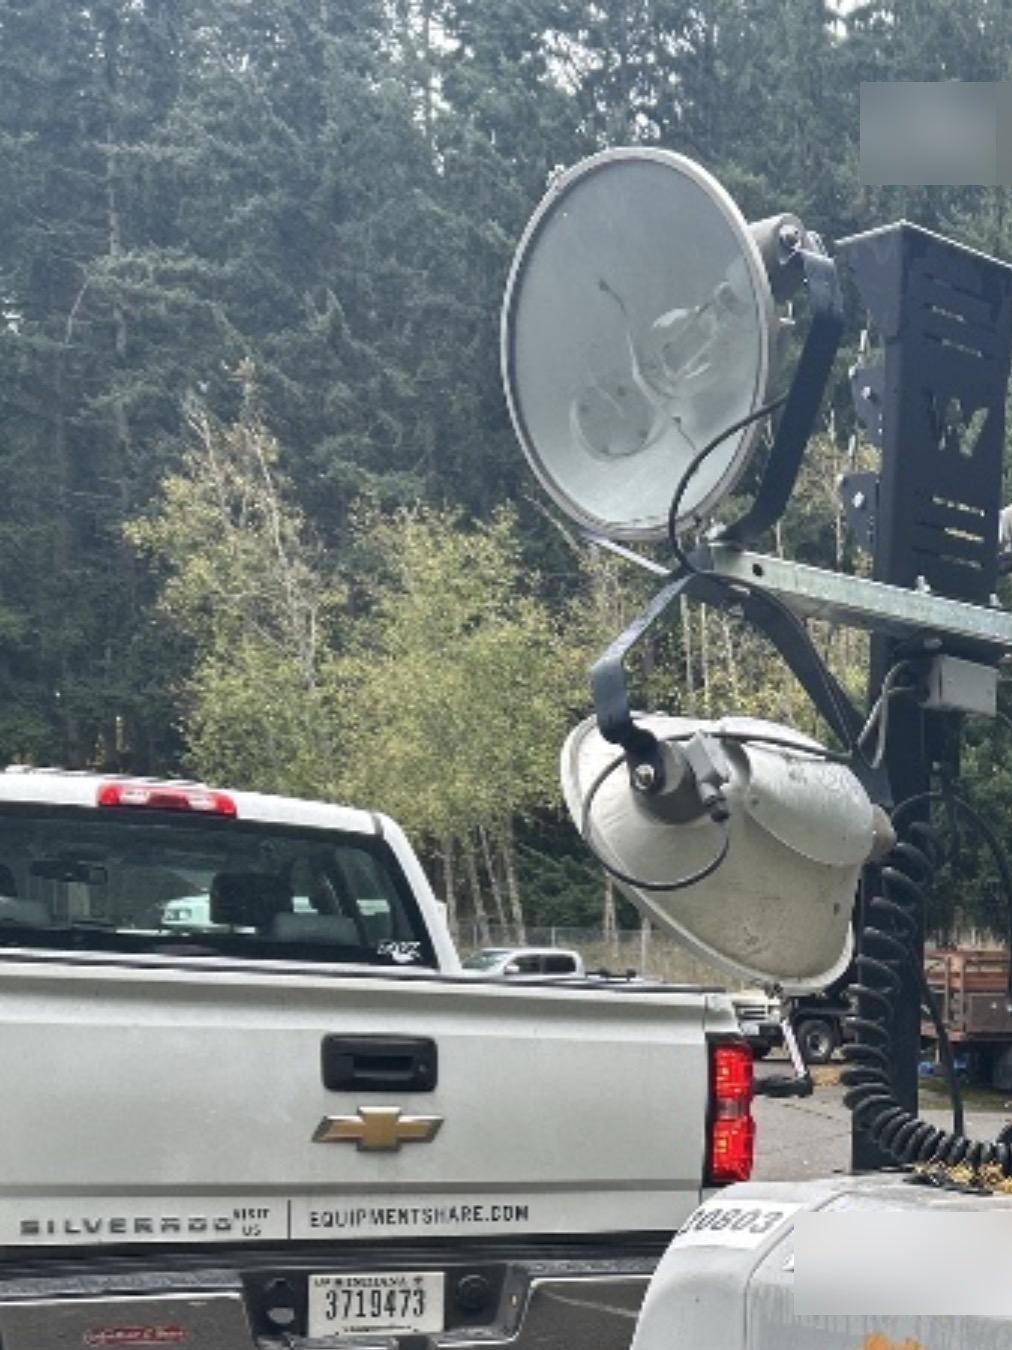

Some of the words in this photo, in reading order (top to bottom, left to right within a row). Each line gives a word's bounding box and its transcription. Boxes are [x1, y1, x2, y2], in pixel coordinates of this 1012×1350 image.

[19, 1217, 233, 1236] SILVERADO
[309, 1205, 529, 1228] EQUIPMENTSHARE.COM
[325, 1289, 425, 1320] 3719473
